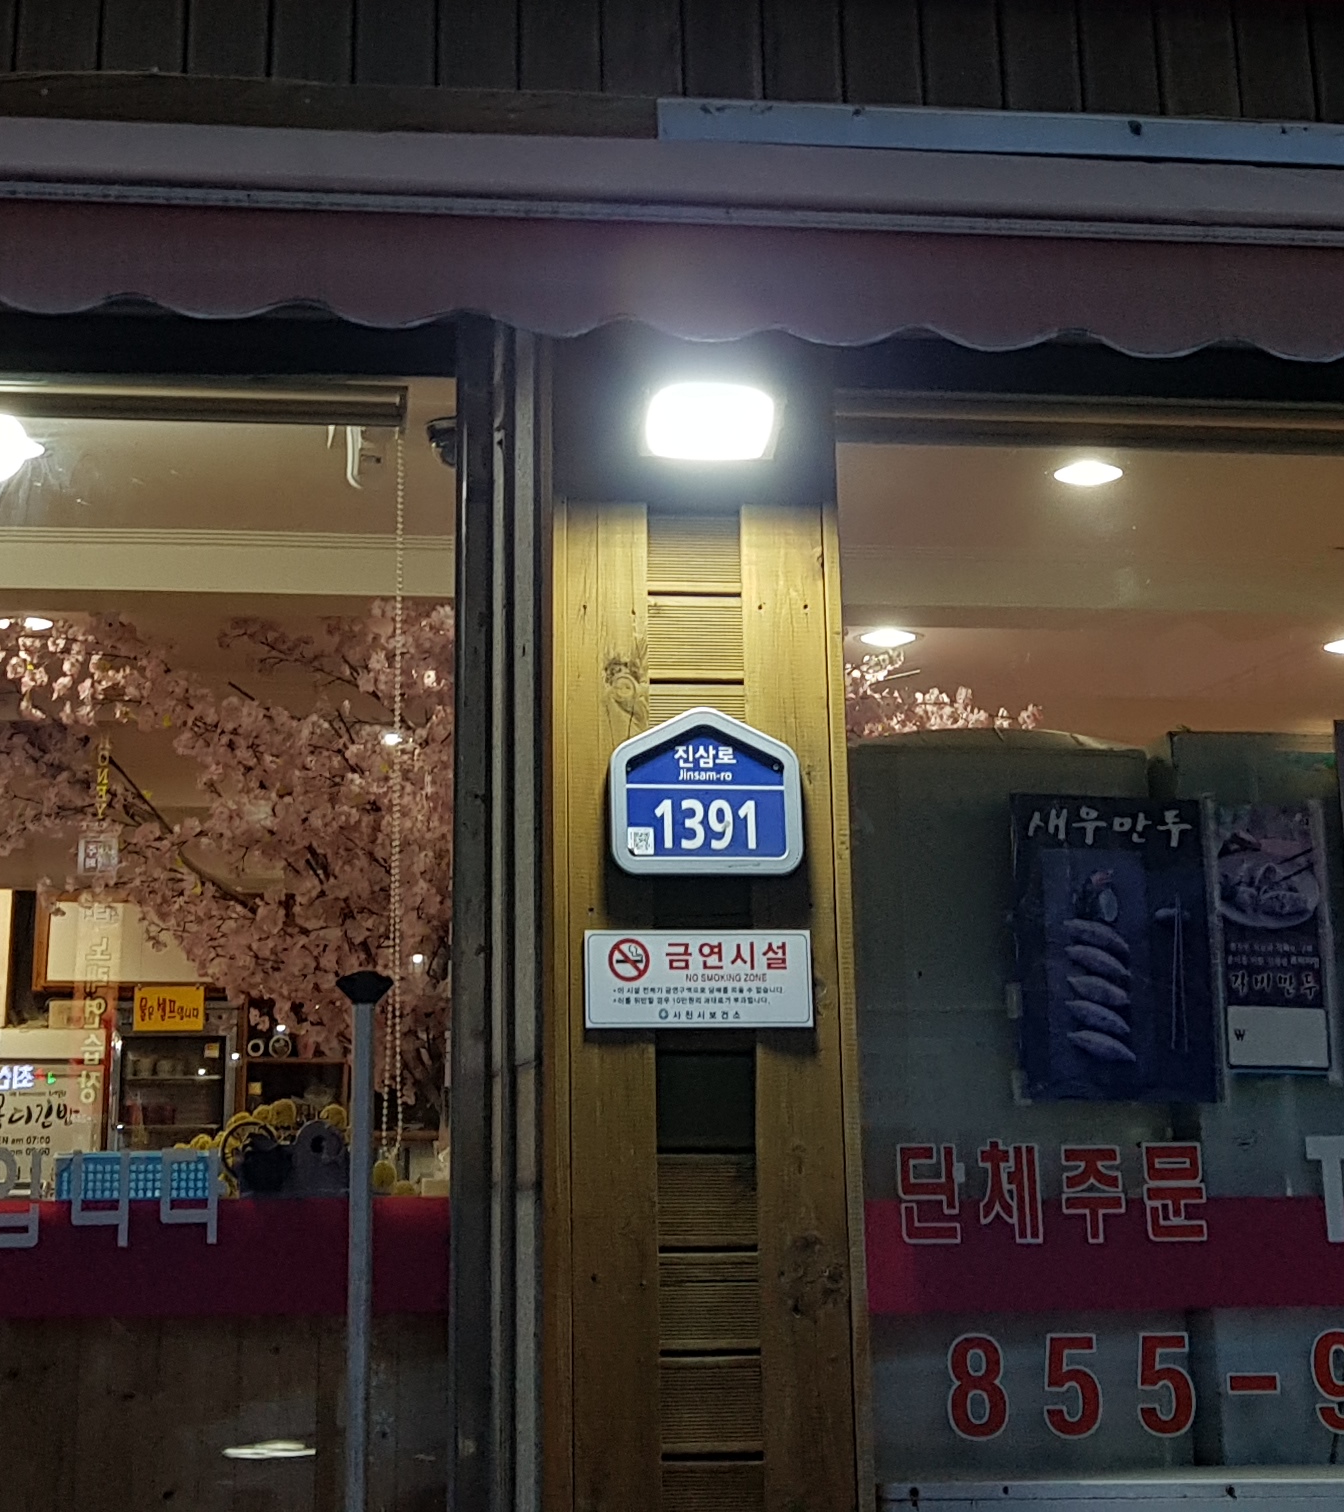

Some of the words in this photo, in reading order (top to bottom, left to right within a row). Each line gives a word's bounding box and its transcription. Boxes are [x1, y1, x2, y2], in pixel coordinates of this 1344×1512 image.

[673, 744, 737, 768] 진삼로
[678, 768, 733, 782] Jinsam-ro
[654, 798, 757, 851] 1391
[1027, 805, 1193, 848] 새우만두
[665, 941, 788, 971] 금연시설
[685, 973, 699, 982] NO
[701, 973, 741, 982] SMOKING
[744, 973, 767, 982] ZONE
[895, 1139, 1208, 1245] 단체주문
